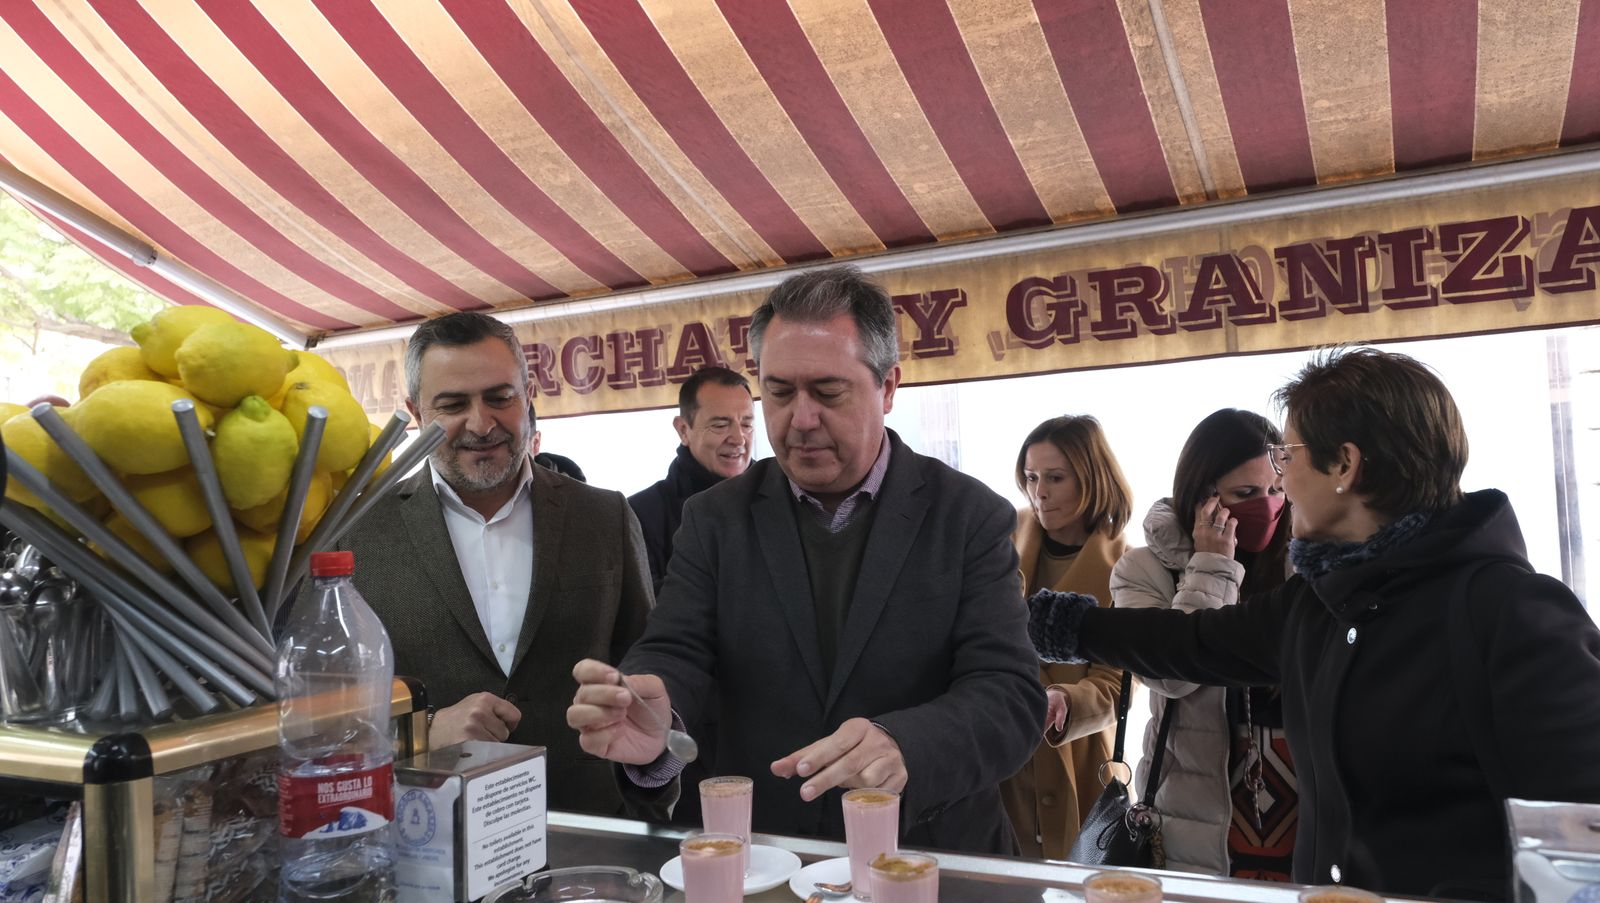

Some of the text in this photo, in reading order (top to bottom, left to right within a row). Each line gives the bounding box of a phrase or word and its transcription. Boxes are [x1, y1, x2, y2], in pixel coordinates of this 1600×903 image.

[892, 288, 967, 359] Y
[318, 776, 372, 794] NOS GUSTA LO
